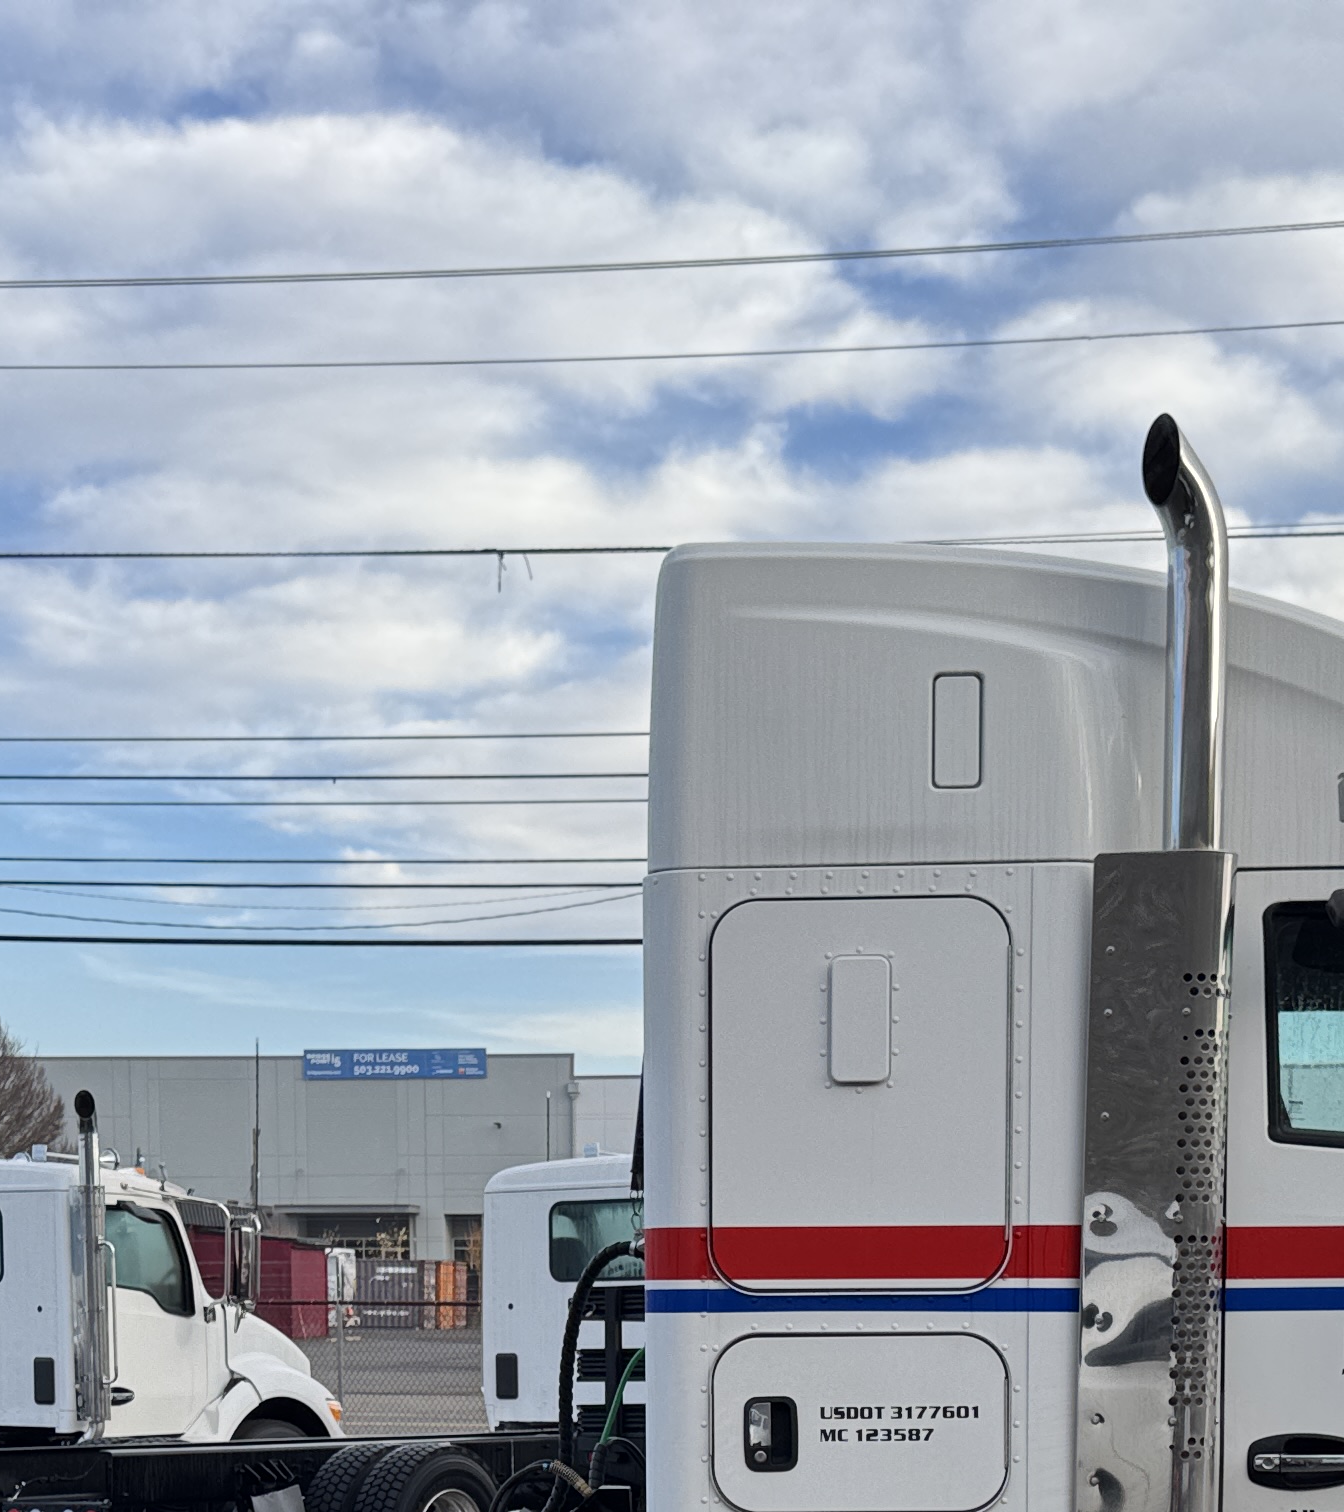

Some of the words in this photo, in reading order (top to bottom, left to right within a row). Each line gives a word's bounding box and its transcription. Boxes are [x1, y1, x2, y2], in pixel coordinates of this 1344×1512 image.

[353, 1052, 374, 1063] FOR
[376, 1051, 408, 1063] LEASE
[820, 1406, 885, 1420] USDOT
[890, 1405, 980, 1419] 3177601
[820, 1428, 848, 1442] MC
[855, 1428, 935, 1442] 123587
